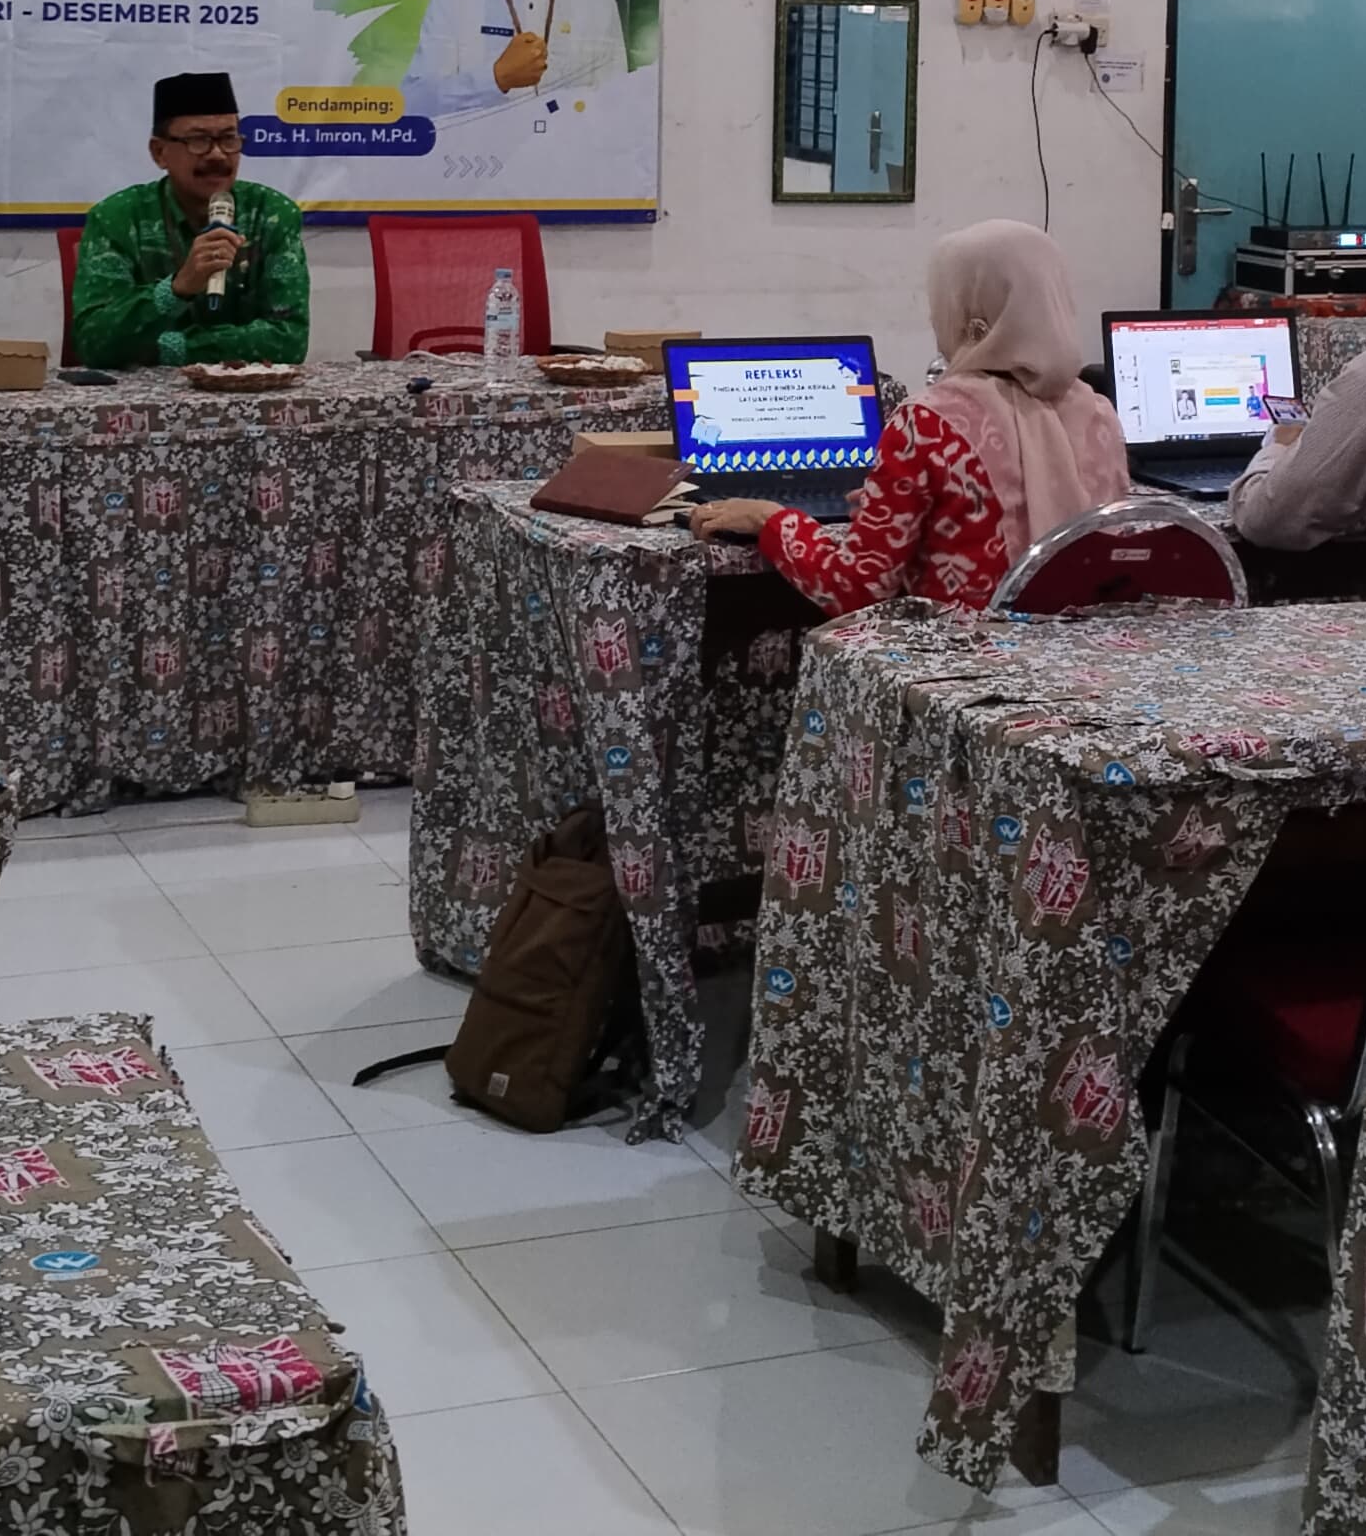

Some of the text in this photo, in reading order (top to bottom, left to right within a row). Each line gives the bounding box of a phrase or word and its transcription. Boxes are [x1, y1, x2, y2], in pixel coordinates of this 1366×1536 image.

[42, 1, 191, 24] DESEMBER
[199, 4, 260, 26] 2025
[286, 97, 394, 115] Pendamping:
[253, 128, 418, 145] Drs. H. Imron, M.Pd.
[745, 369, 802, 379] REFLEKSI
